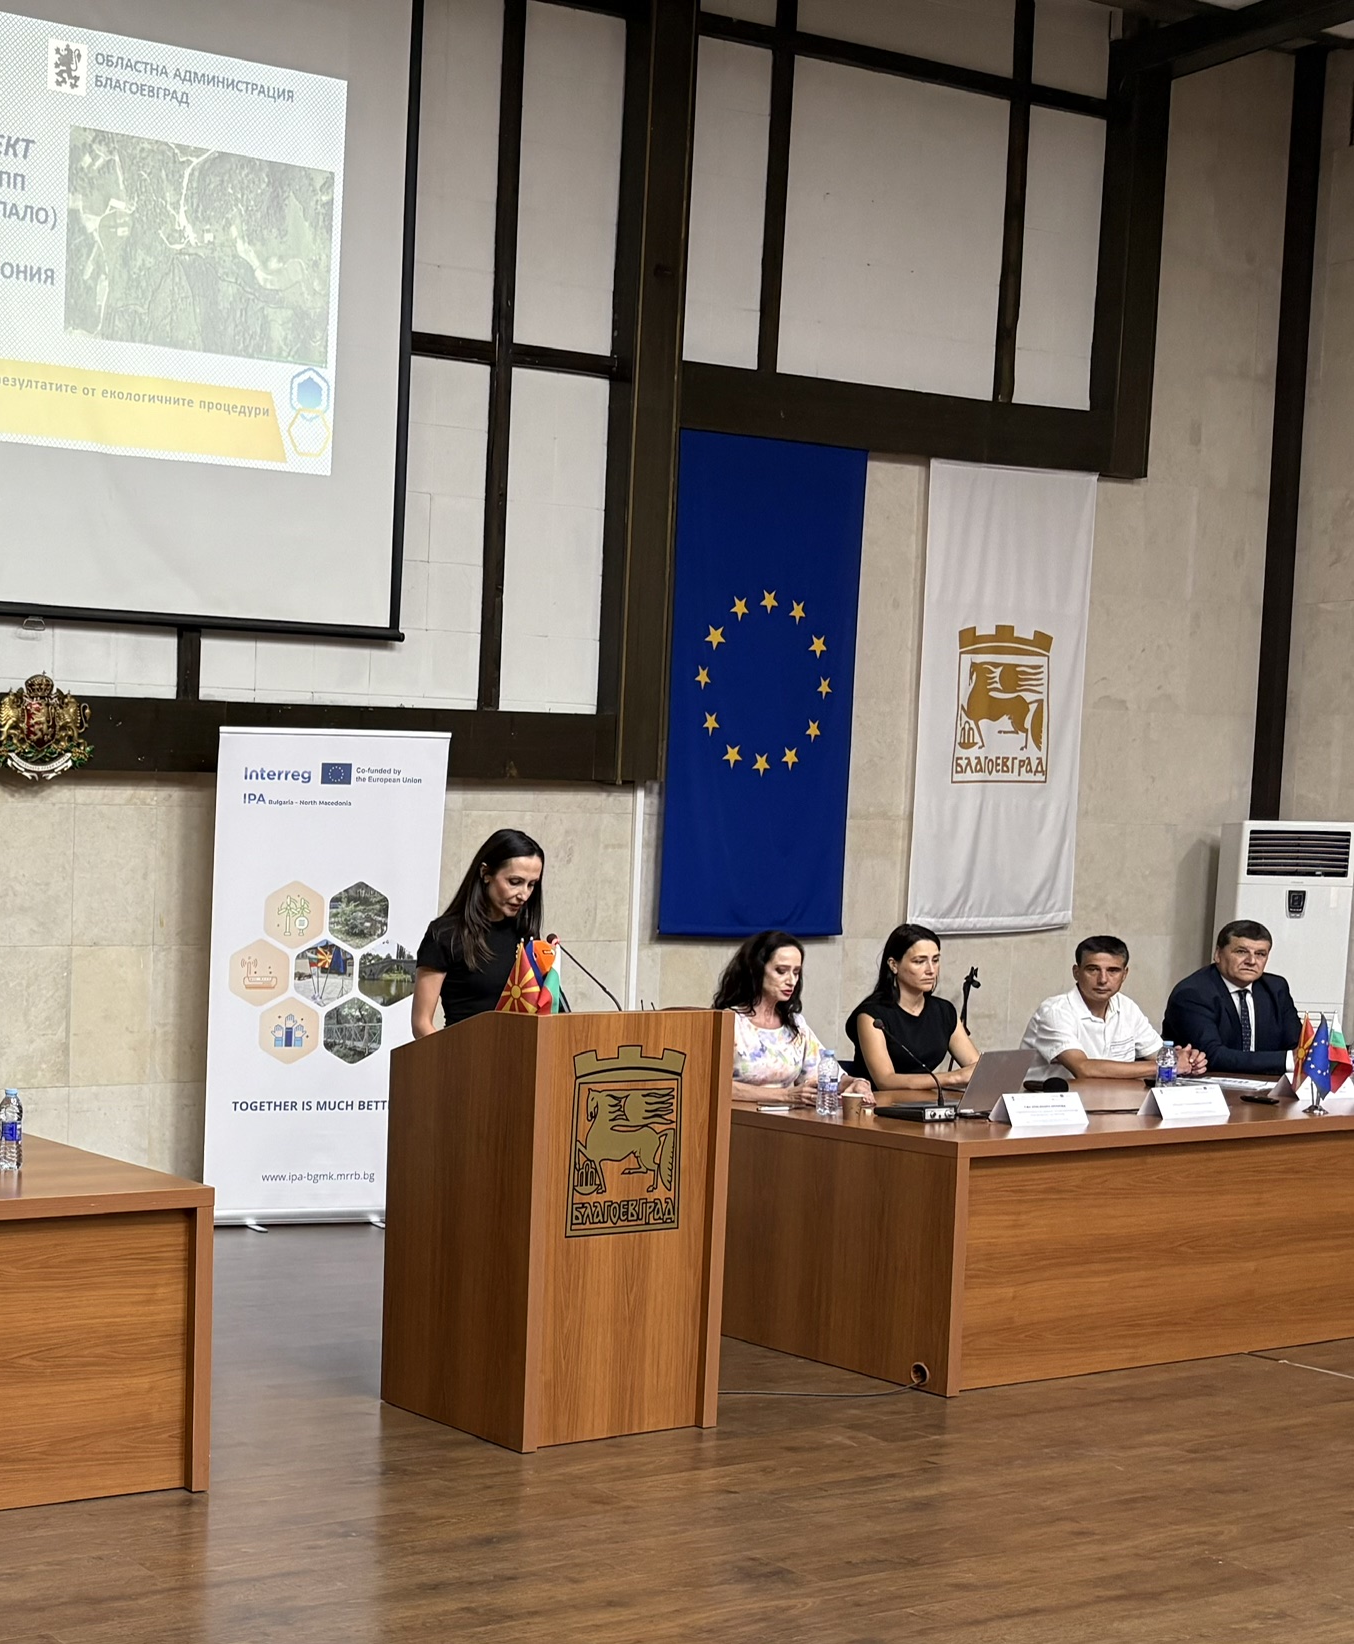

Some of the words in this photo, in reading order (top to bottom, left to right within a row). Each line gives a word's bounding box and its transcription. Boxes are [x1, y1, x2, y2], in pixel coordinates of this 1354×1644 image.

[95, 52, 169, 78] ОБЛАСТНА
[173, 67, 295, 103] АДМИНИСТРАЦИЯ
[95, 75, 190, 108] БЛАГОЕВГРАД
[82, 386, 96, 397] от
[101, 387, 194, 408] екологичните
[199, 399, 270, 418] процедури
[244, 766, 312, 784] Interreg
[356, 767, 392, 775] Co-funded
[393, 767, 402, 776] by
[955, 756, 1046, 777] БЛАГОЕВГРАД
[368, 776, 401, 785] European
[402, 776, 422, 784] Union
[243, 792, 266, 805] IPA
[232, 1101, 297, 1112] TOGETHER
[302, 1101, 312, 1112] IS
[316, 1100, 354, 1111] MUCH
[358, 1100, 388, 1111] BETT
[262, 1171, 375, 1183] www.ipa-bgmk.mrrb.bg
[571, 1197, 675, 1225] БЛАГОЕВГРАД
